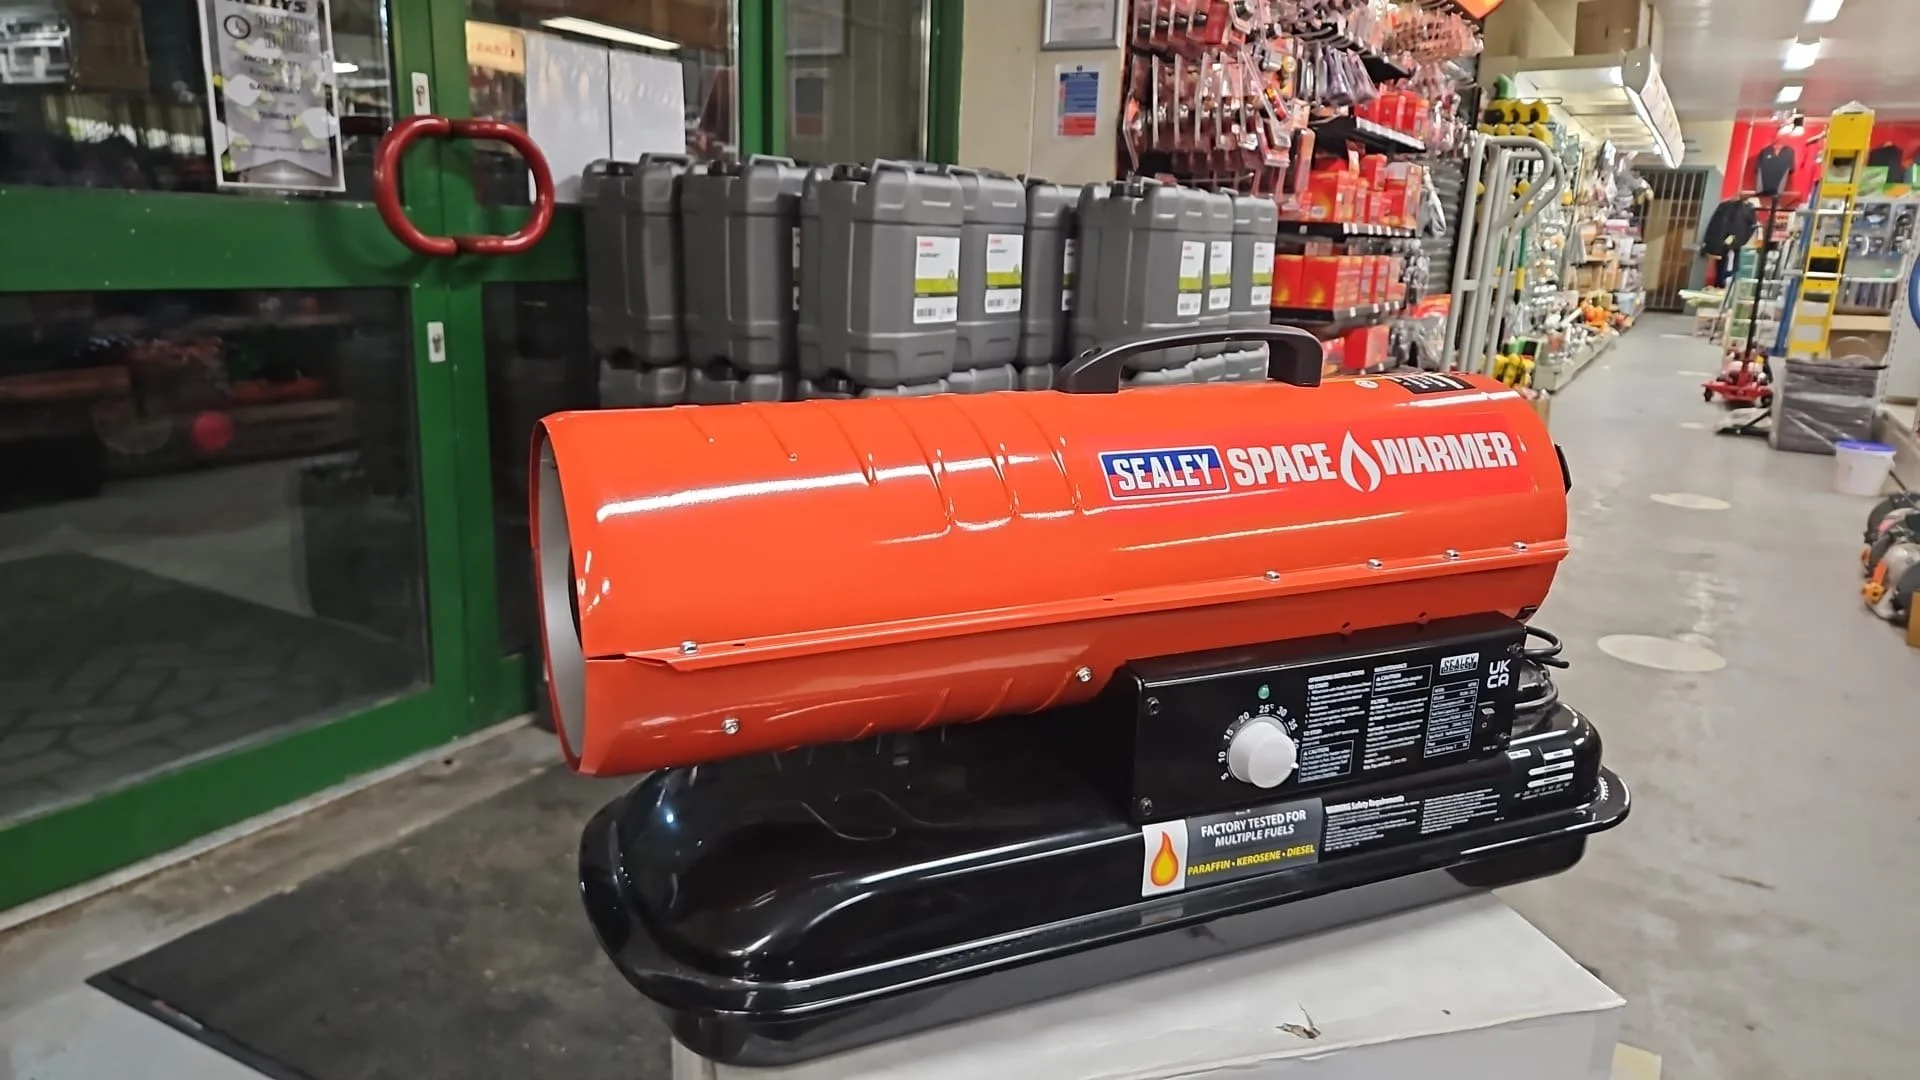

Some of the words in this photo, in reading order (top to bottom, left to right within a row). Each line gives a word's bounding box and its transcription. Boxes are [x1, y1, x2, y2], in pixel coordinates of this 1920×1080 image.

[1112, 453, 1214, 491] SEALEY
[1226, 443, 1338, 487] SPACE
[1371, 431, 1519, 476] WARMER
[1442, 655, 1476, 672] SEALEY
[1489, 659, 1511, 674] UK
[1486, 673, 1509, 689] CA
[1238, 712, 1250, 723] 20
[1276, 706, 1288, 716] 30
[1288, 718, 1298, 730] 35
[1224, 728, 1234, 740] 15
[1218, 751, 1226, 763] 10
[1220, 772, 1229, 780] 5
[1201, 820, 1247, 838] FACTORY
[1248, 814, 1284, 830] TESTED
[1286, 809, 1306, 822] FOR
[1215, 830, 1264, 848] MULTIPLE
[1264, 824, 1295, 839] FUELS
[1188, 860, 1230, 876] PARAFFIN
[1236, 850, 1280, 866] KEROSENE
[1286, 844, 1316, 857] DIESEL
